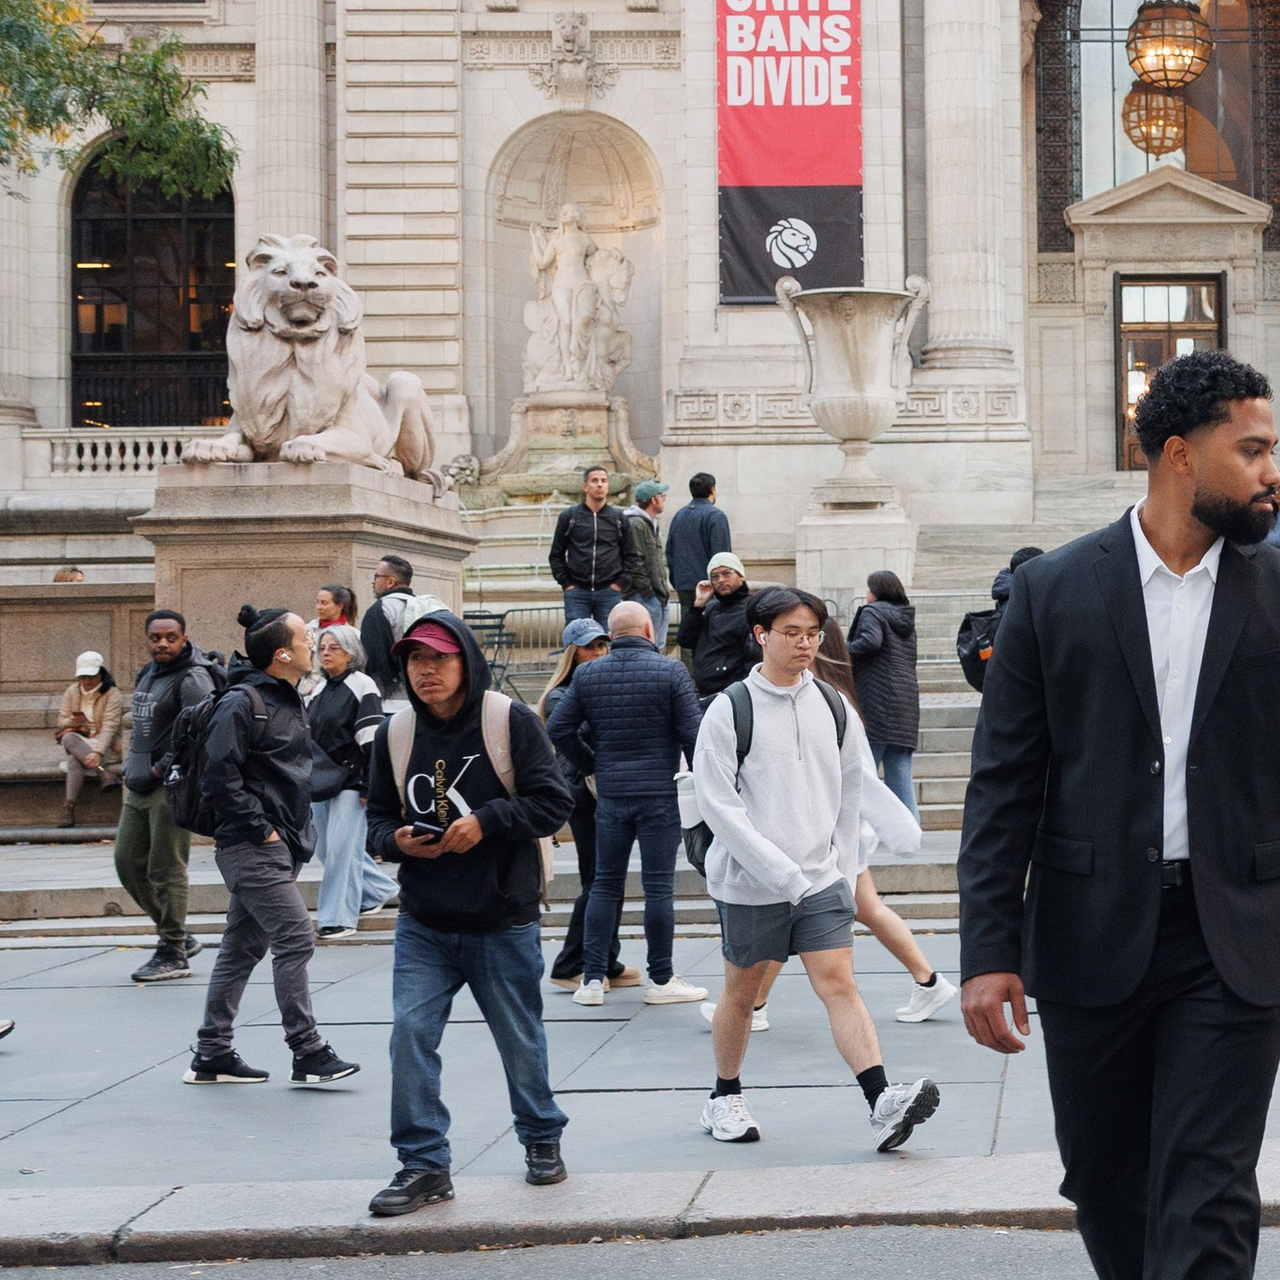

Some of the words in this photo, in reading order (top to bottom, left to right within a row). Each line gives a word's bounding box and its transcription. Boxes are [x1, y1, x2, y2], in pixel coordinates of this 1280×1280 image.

[726, 14, 852, 53] BANS
[726, 55, 853, 107] DIVIDE
[435, 759, 447, 798] Calvin
[437, 799, 450, 827] Klein
